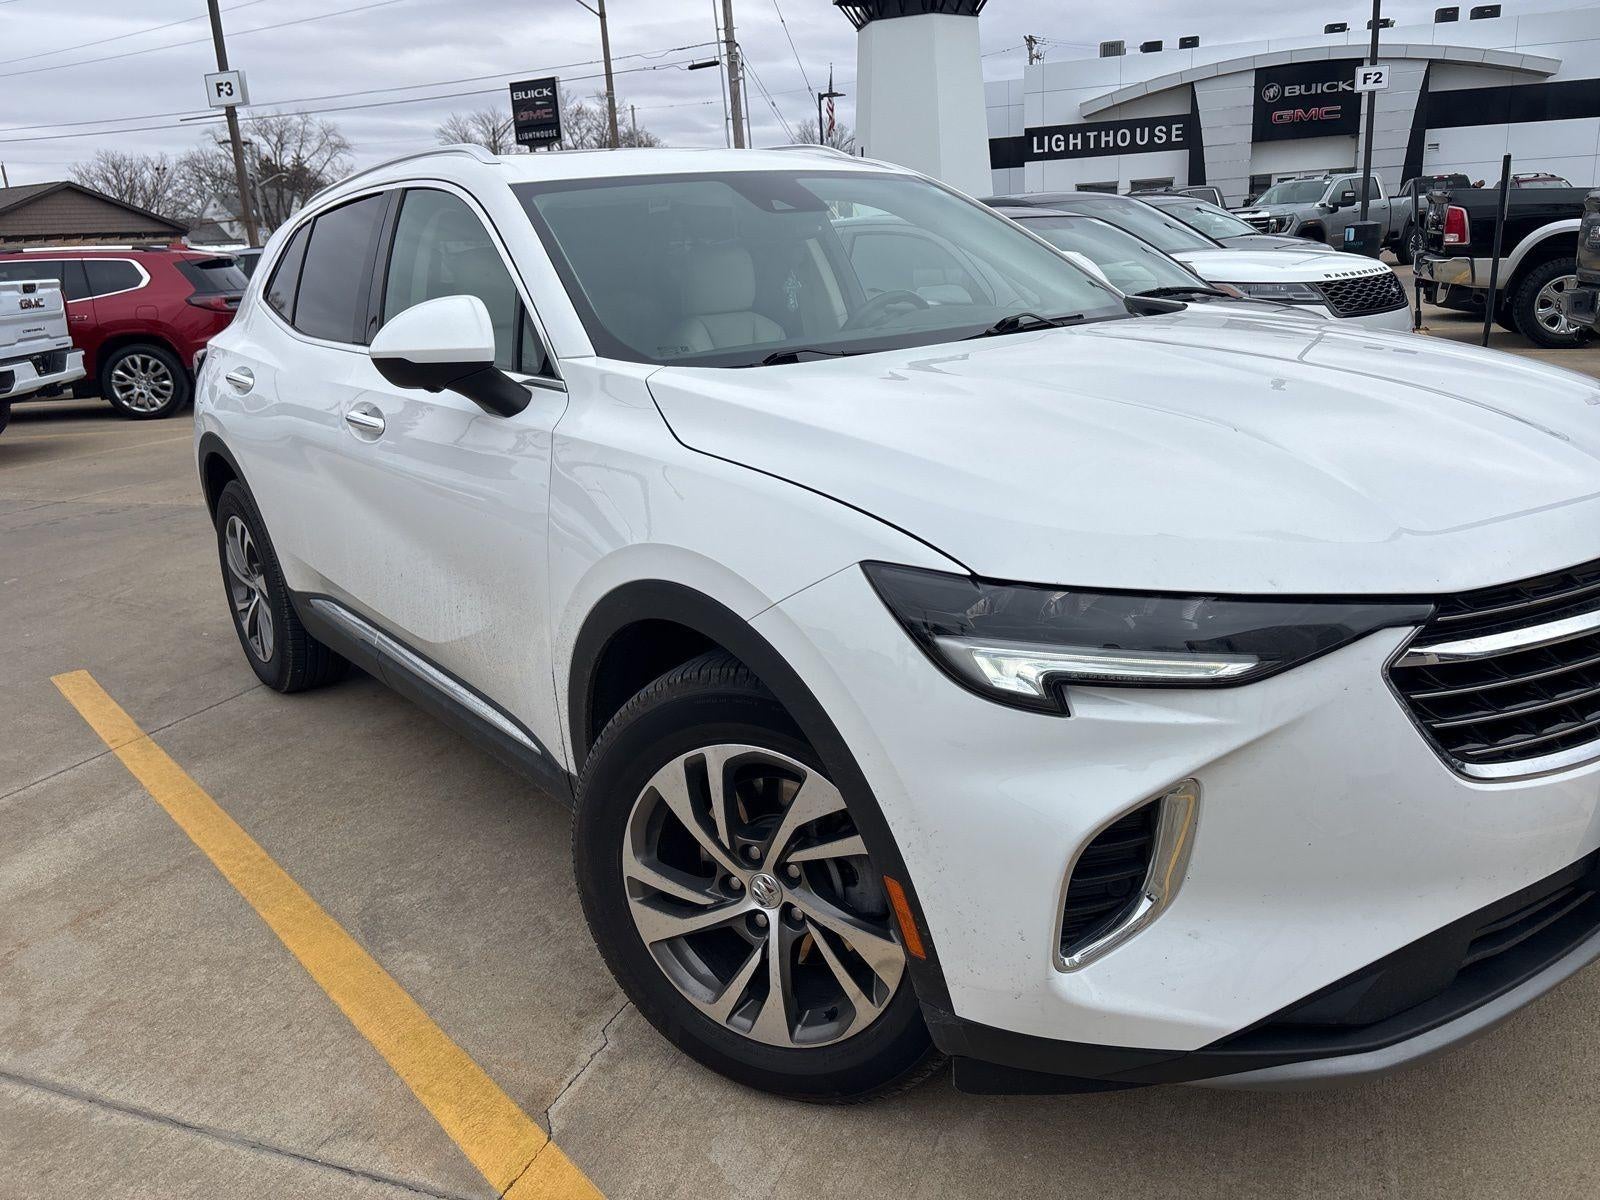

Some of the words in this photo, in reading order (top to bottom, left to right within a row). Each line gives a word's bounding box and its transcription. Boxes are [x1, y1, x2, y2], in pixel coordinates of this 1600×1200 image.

[1362, 71, 1383, 85] F2
[215, 81, 234, 98] F3
[512, 87, 553, 101] BUICK
[1284, 79, 1355, 97] BUICK
[517, 108, 553, 121] GMC
[1271, 105, 1342, 124] GMC
[518, 129, 557, 141] LIGHTHOUSE
[1032, 123, 1184, 154] LIGHTHOUSE
[19, 297, 46, 310] GMC
